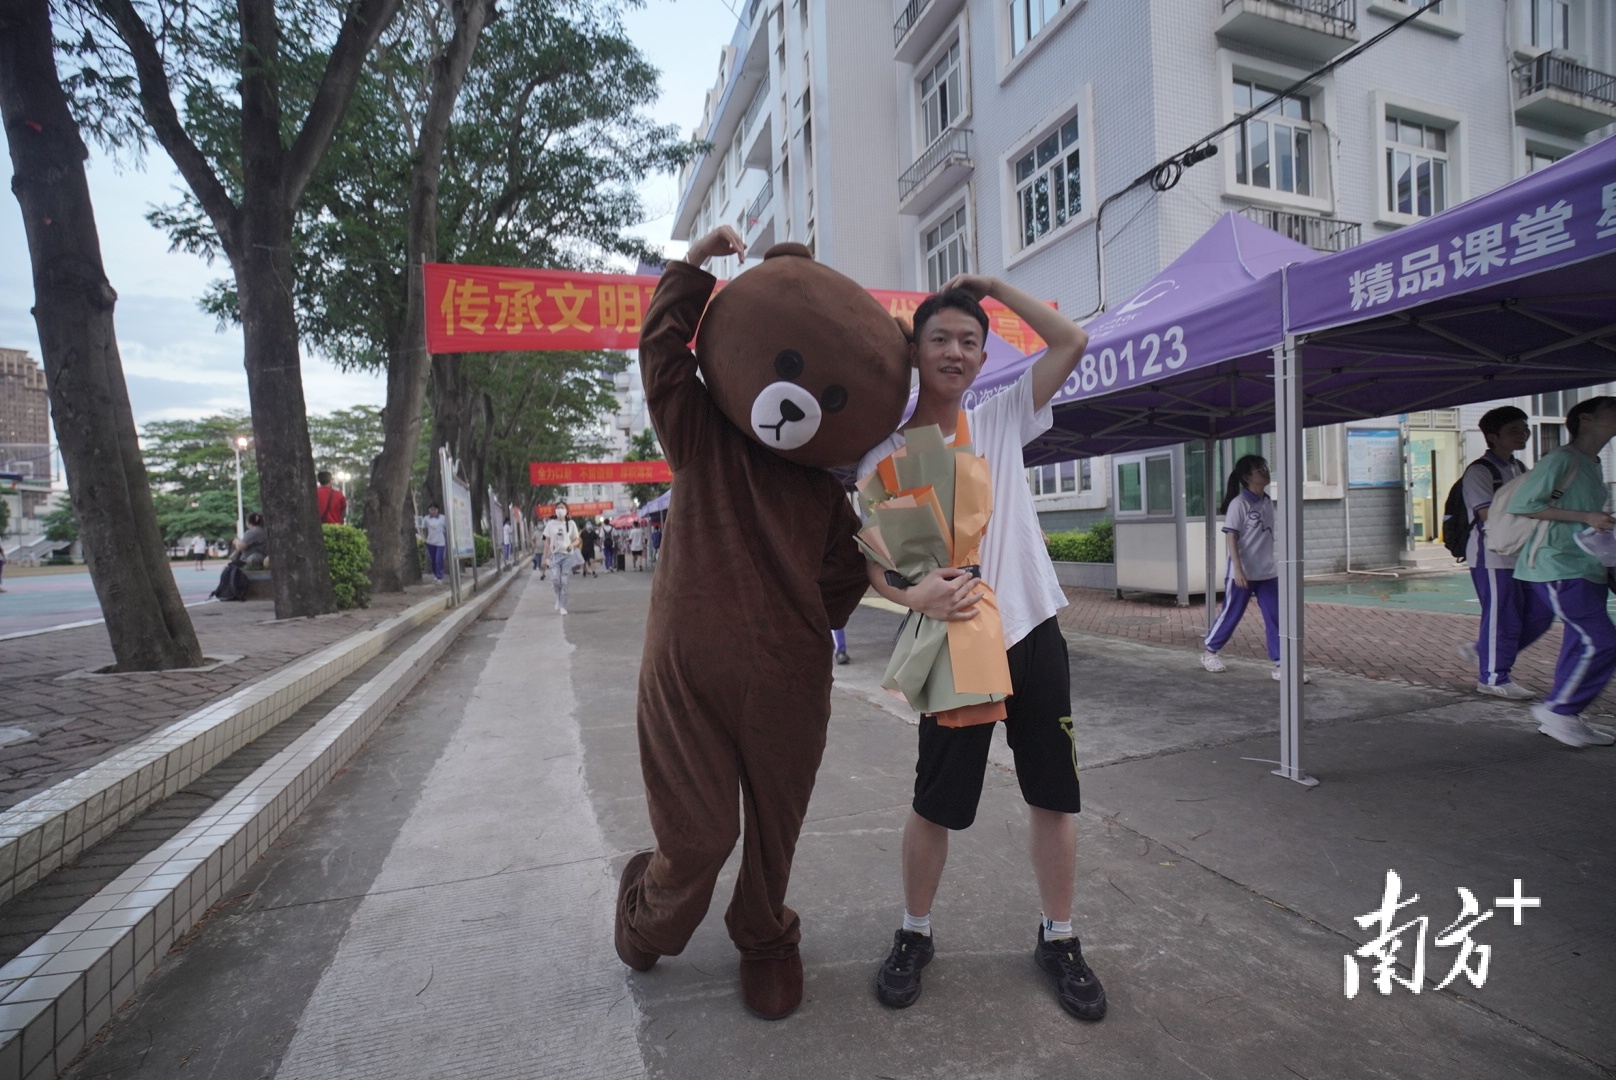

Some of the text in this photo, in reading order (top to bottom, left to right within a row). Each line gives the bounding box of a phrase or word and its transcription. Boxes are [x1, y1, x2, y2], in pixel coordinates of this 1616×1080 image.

[1349, 199, 1576, 312] 精品课堂
[440, 277, 654, 336] 传承文明
[1050, 325, 1188, 400] 580123
[537, 466, 573, 481] 全力以赴
